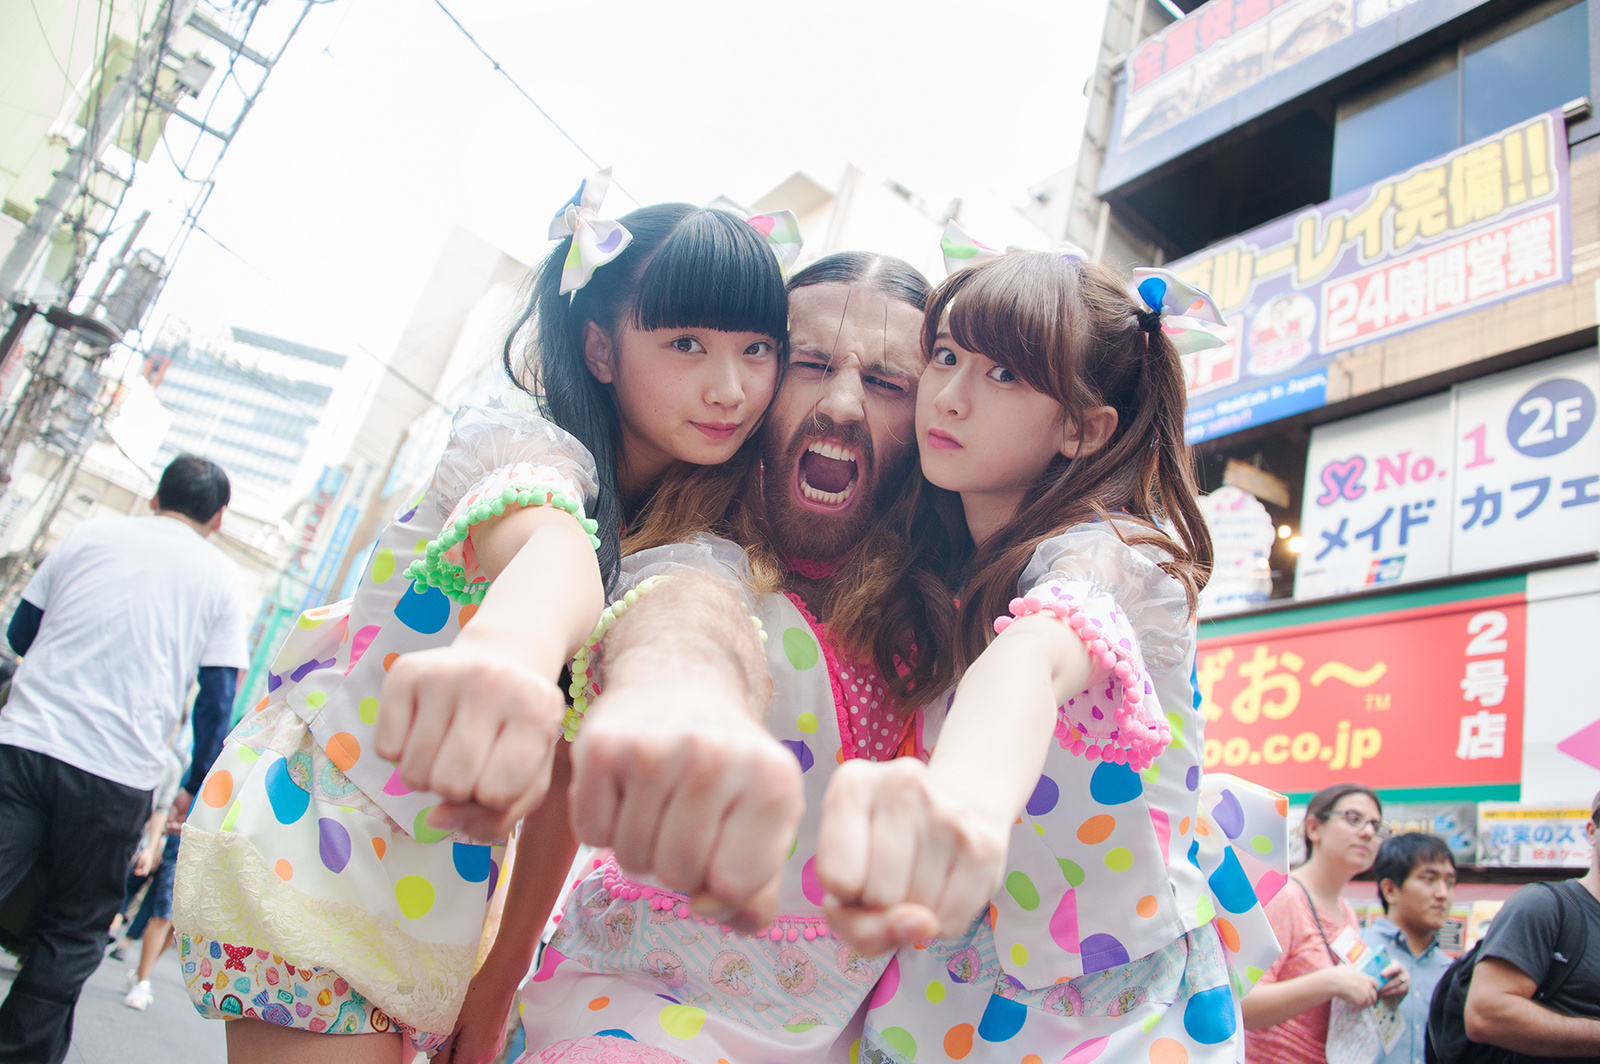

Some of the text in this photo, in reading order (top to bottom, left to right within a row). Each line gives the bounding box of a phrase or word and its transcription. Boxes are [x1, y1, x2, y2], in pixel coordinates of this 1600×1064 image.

[1327, 215, 1553, 343] 24時間営業
[1373, 422, 1496, 492] No. 1
[1516, 396, 1583, 448] 2F
[1363, 692, 1392, 713] TM
[1455, 610, 1509, 760] 2号店
